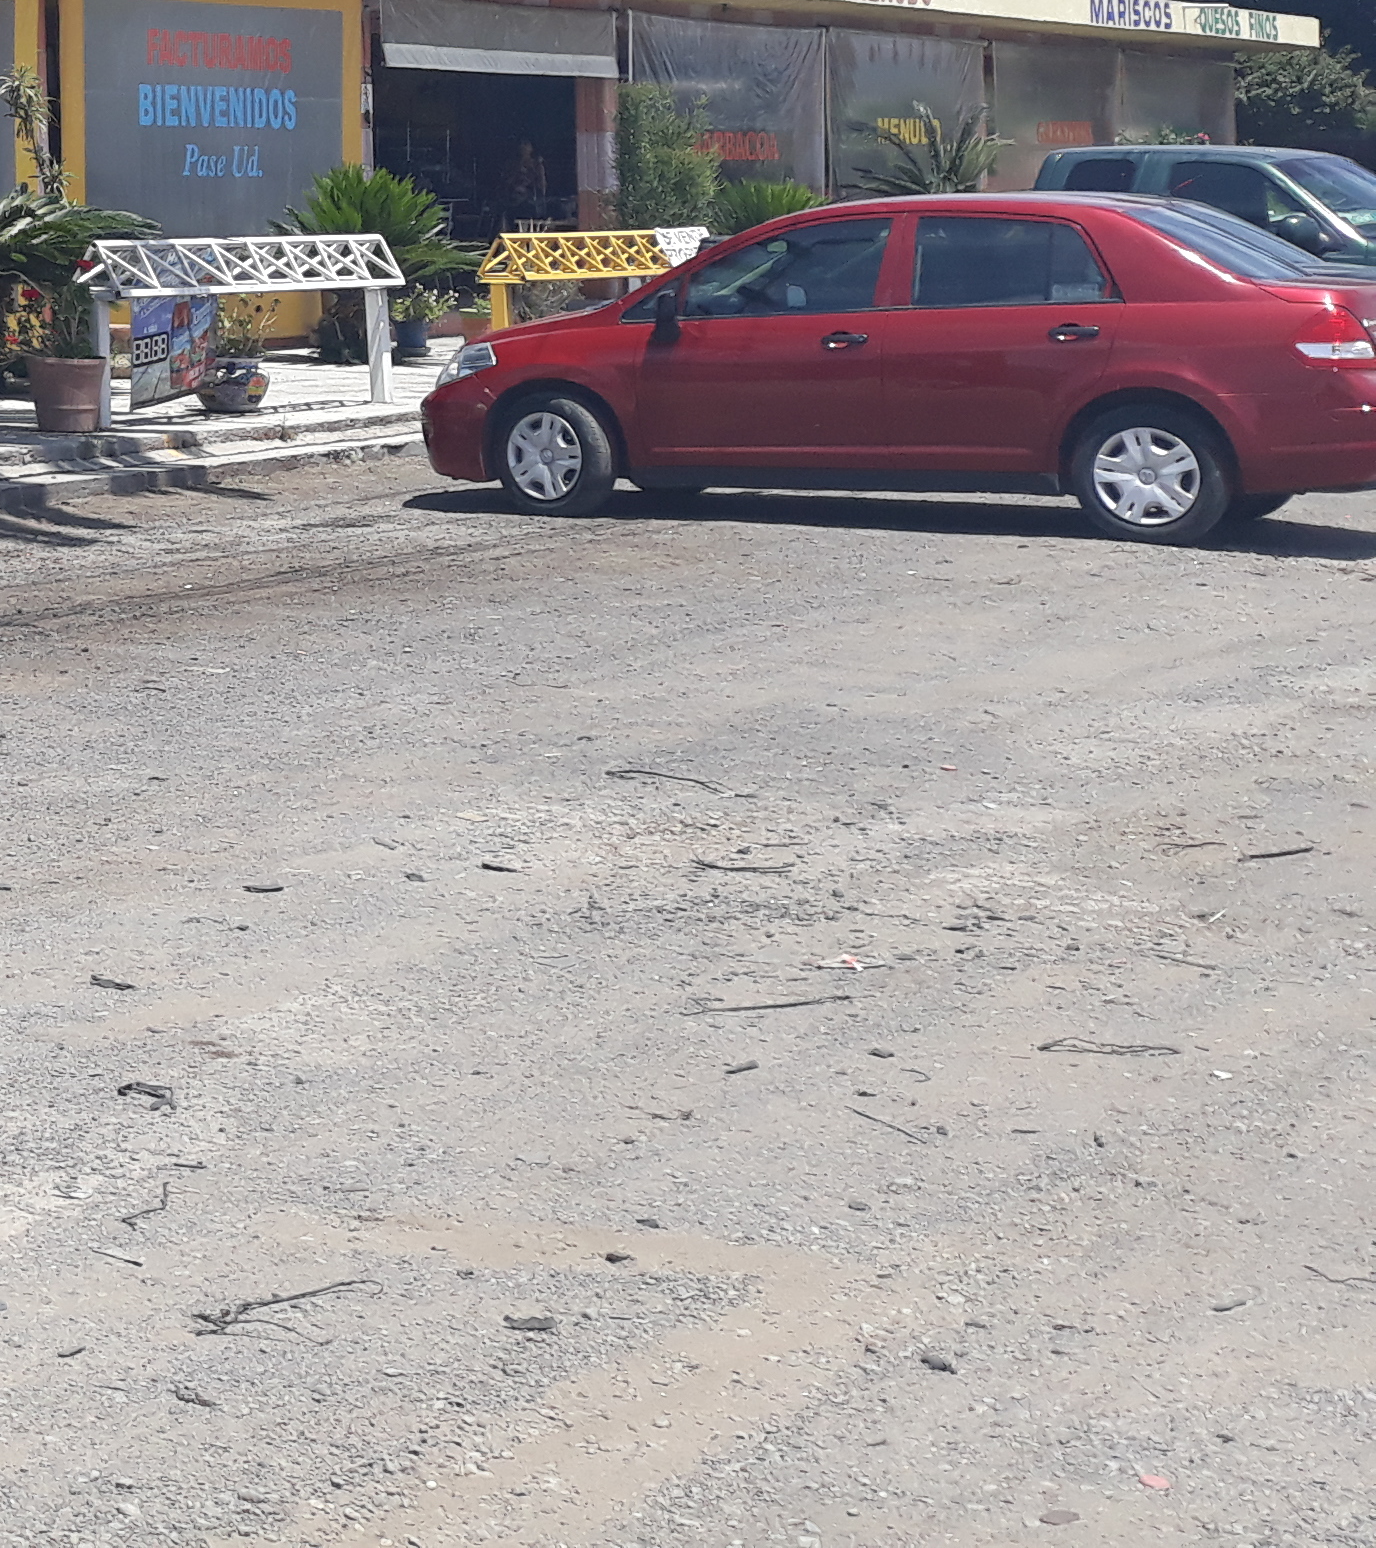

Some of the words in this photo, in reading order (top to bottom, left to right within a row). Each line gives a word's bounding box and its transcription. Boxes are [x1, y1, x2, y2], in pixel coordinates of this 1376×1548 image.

[1198, 7, 1242, 37] QUESOS
[1248, 11, 1279, 41] FINOS
[146, 28, 292, 74] FACTURAMOS
[138, 83, 297, 130] BIENVENIDOS
[181, 144, 227, 177] Pase
[232, 144, 264, 178] Ud.
